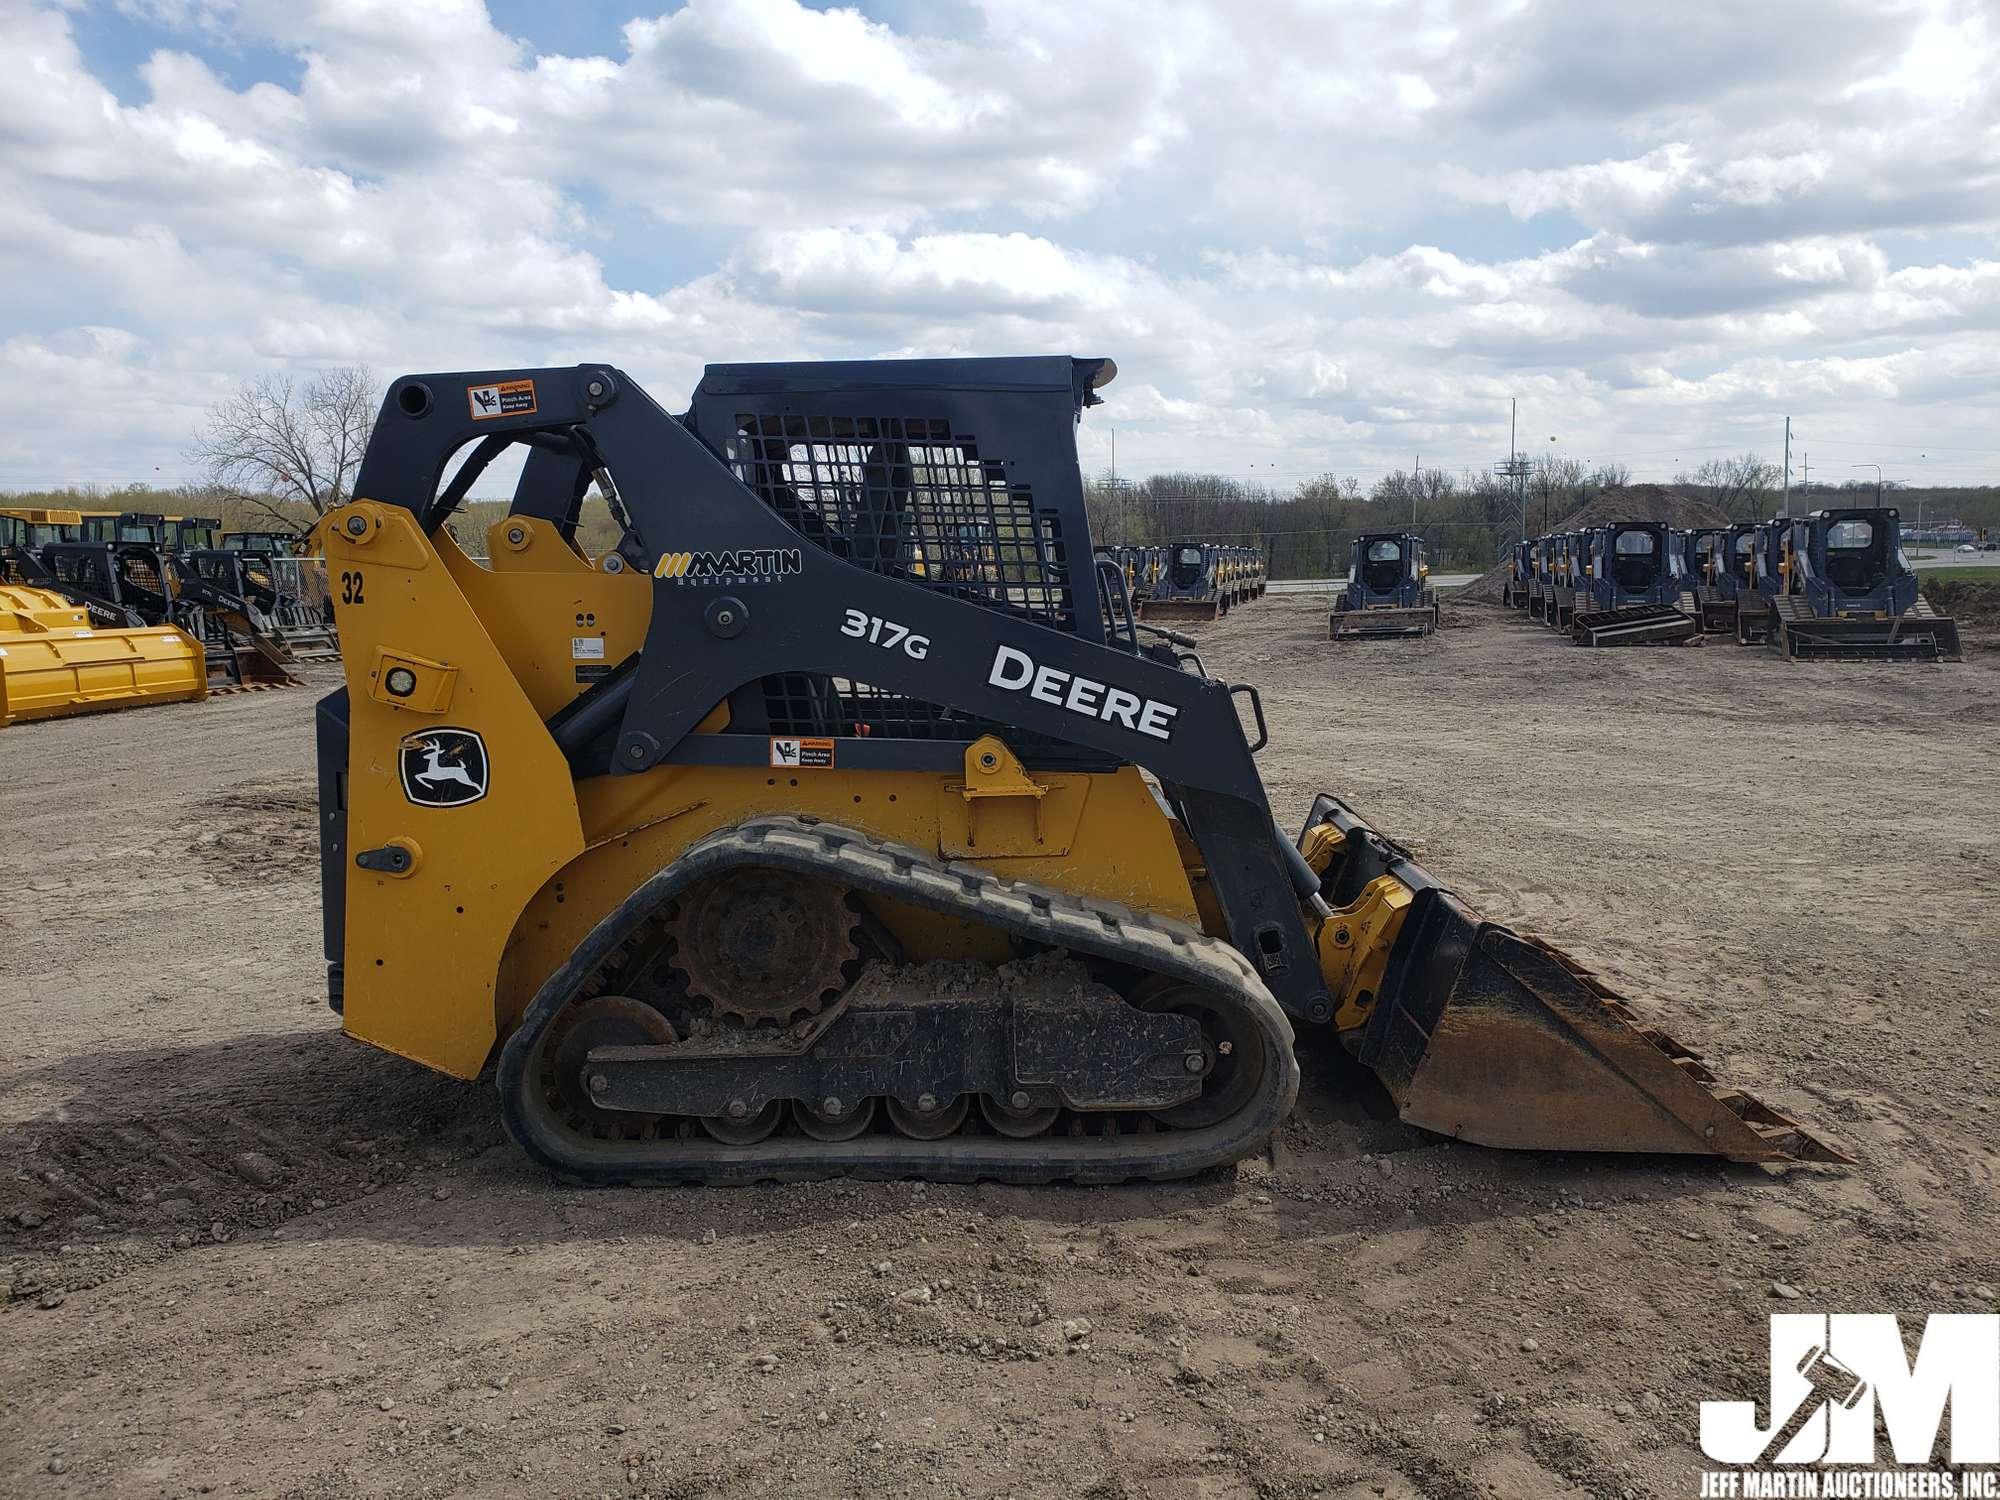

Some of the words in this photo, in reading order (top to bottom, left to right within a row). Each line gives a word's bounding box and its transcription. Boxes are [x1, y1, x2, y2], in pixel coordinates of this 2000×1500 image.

[685, 549, 802, 578] MARTIN
[341, 571, 365, 605] 32
[677, 575, 783, 586] Equipment
[84, 601, 117, 621] DEERE
[840, 608, 931, 661] 317G
[988, 644, 1178, 740] DEERE
